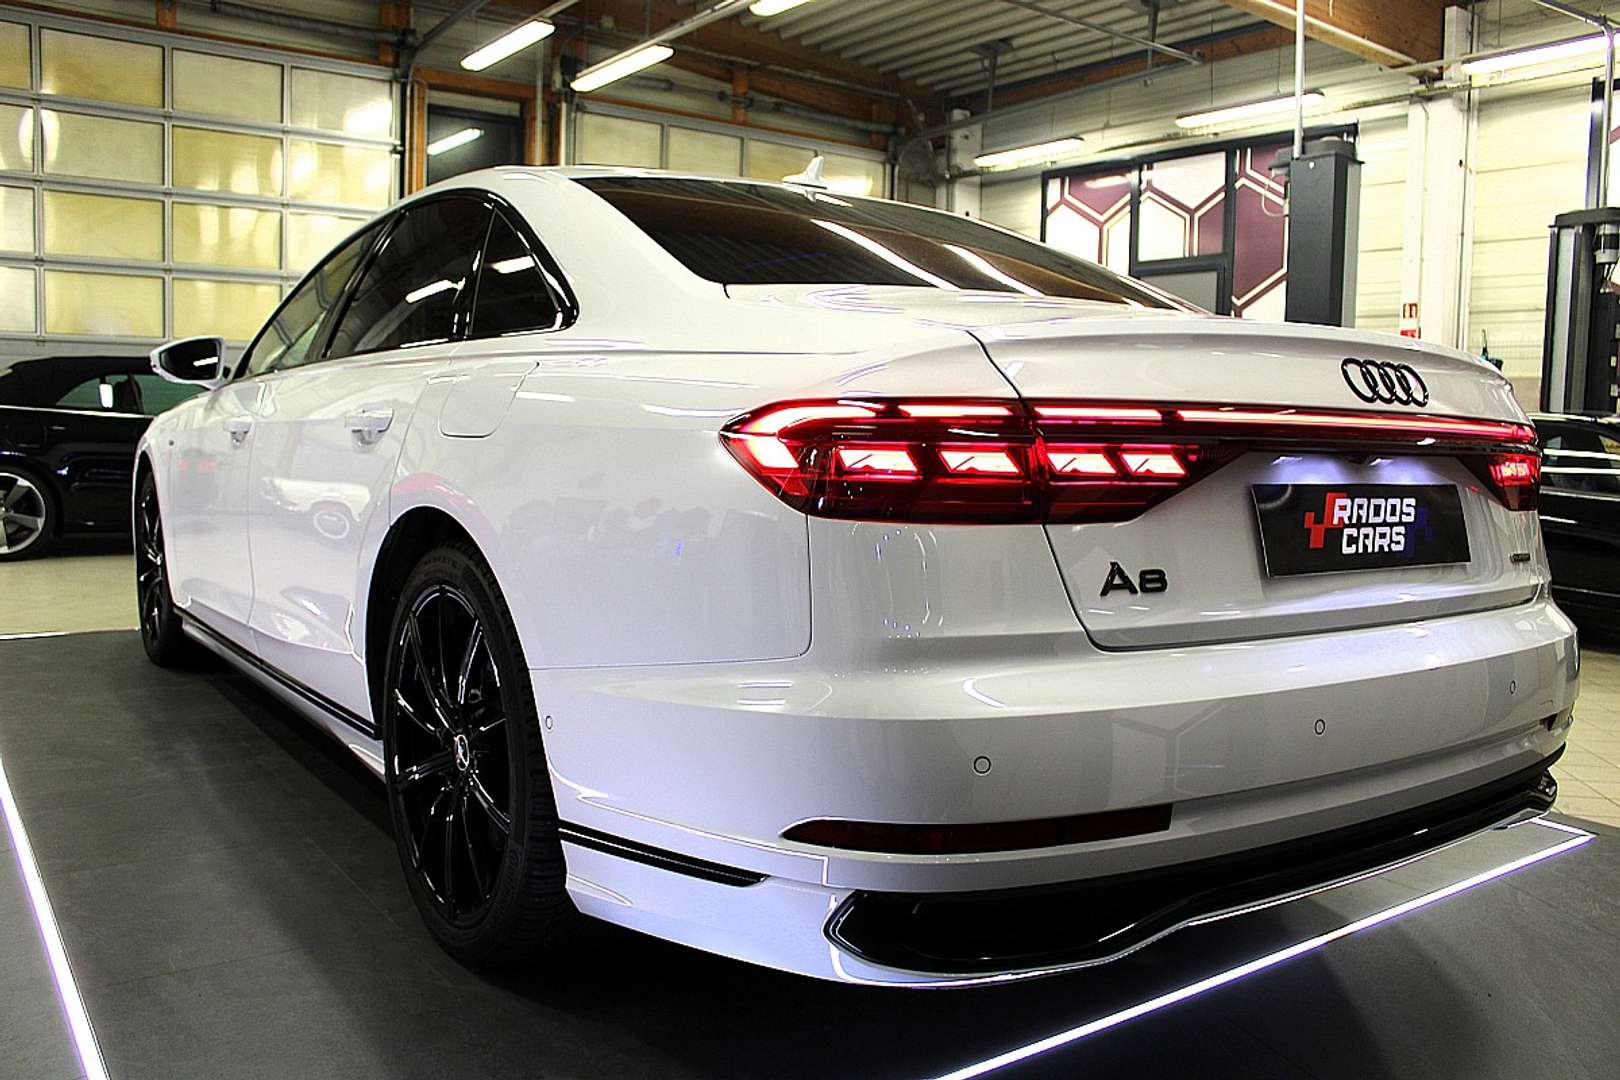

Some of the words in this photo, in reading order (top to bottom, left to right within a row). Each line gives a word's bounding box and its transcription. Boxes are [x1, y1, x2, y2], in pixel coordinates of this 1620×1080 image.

[1332, 497, 1416, 525] RADOS
[1341, 525, 1406, 555] CARS
[1099, 561, 1168, 597] A8
